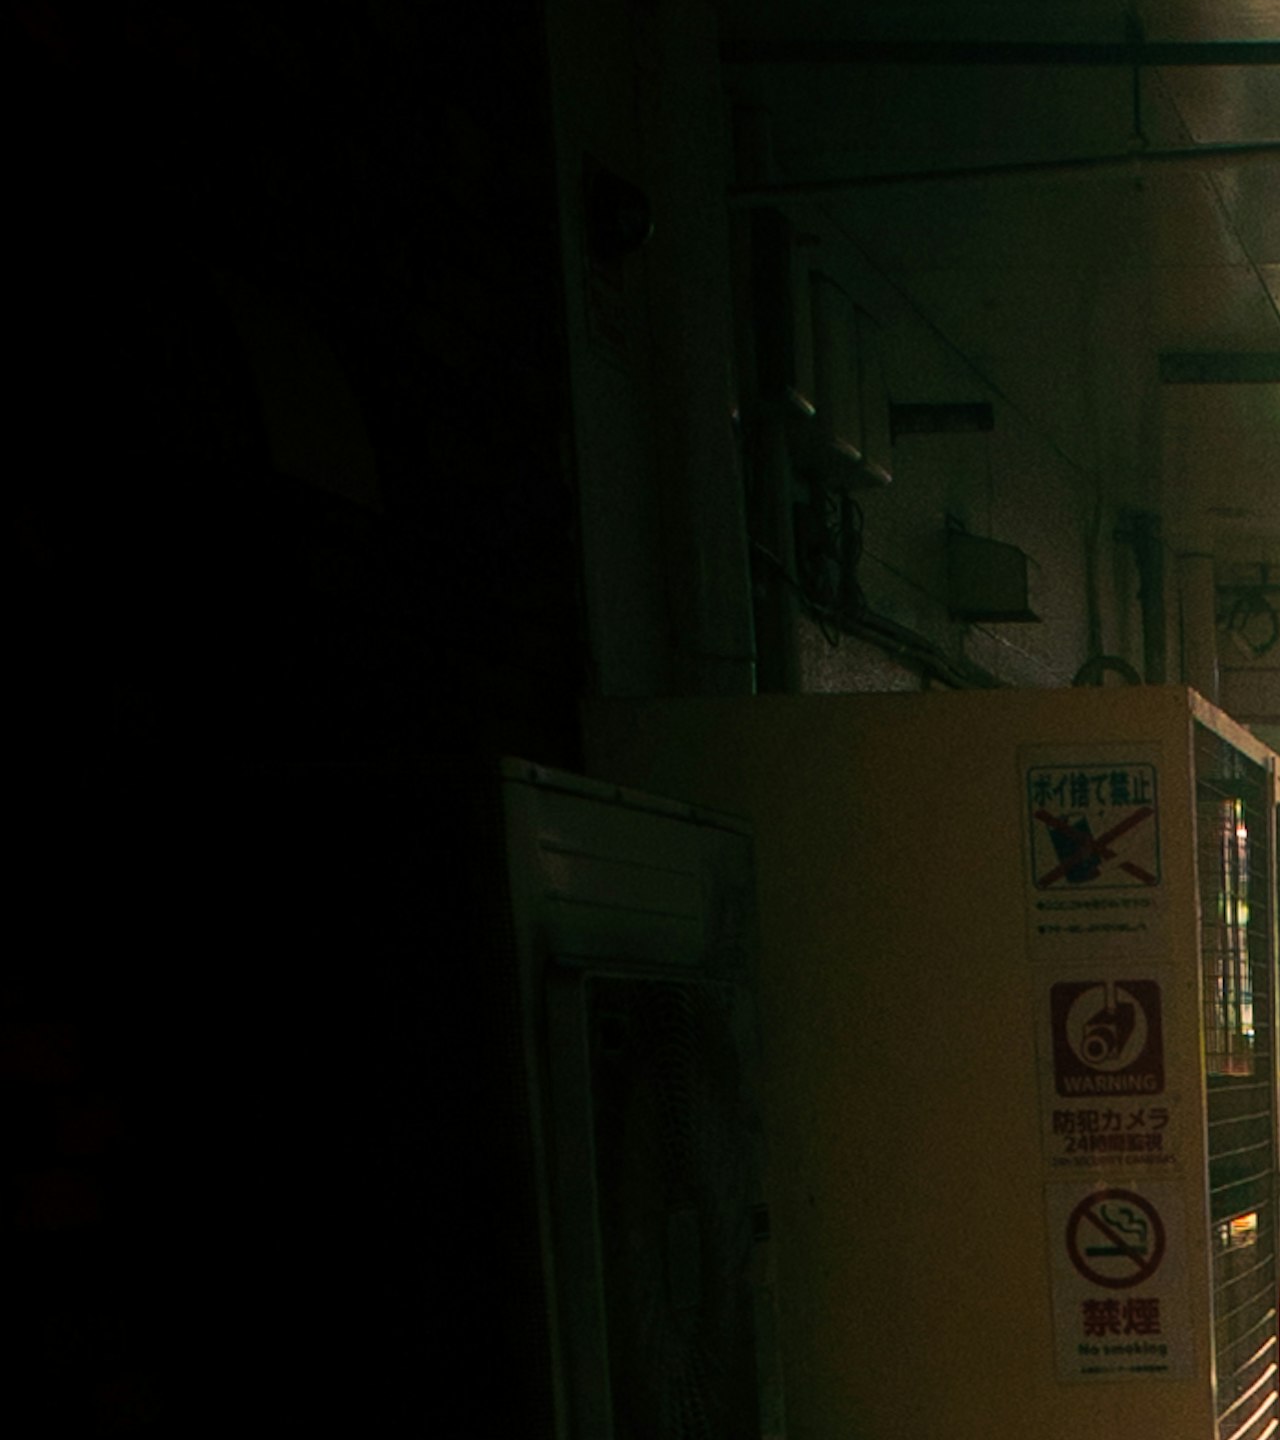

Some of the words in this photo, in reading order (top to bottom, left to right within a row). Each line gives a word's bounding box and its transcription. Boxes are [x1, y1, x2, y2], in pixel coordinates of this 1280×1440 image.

[1033, 769, 1152, 807] ポイ捨て禁止
[1063, 1073, 1158, 1093] WARNING
[1052, 1108, 1169, 1134] 防犯カメラ
[1081, 1298, 1162, 1337] 禁煙
[1078, 1343, 1100, 1356] No
[1103, 1341, 1168, 1358] smoking
